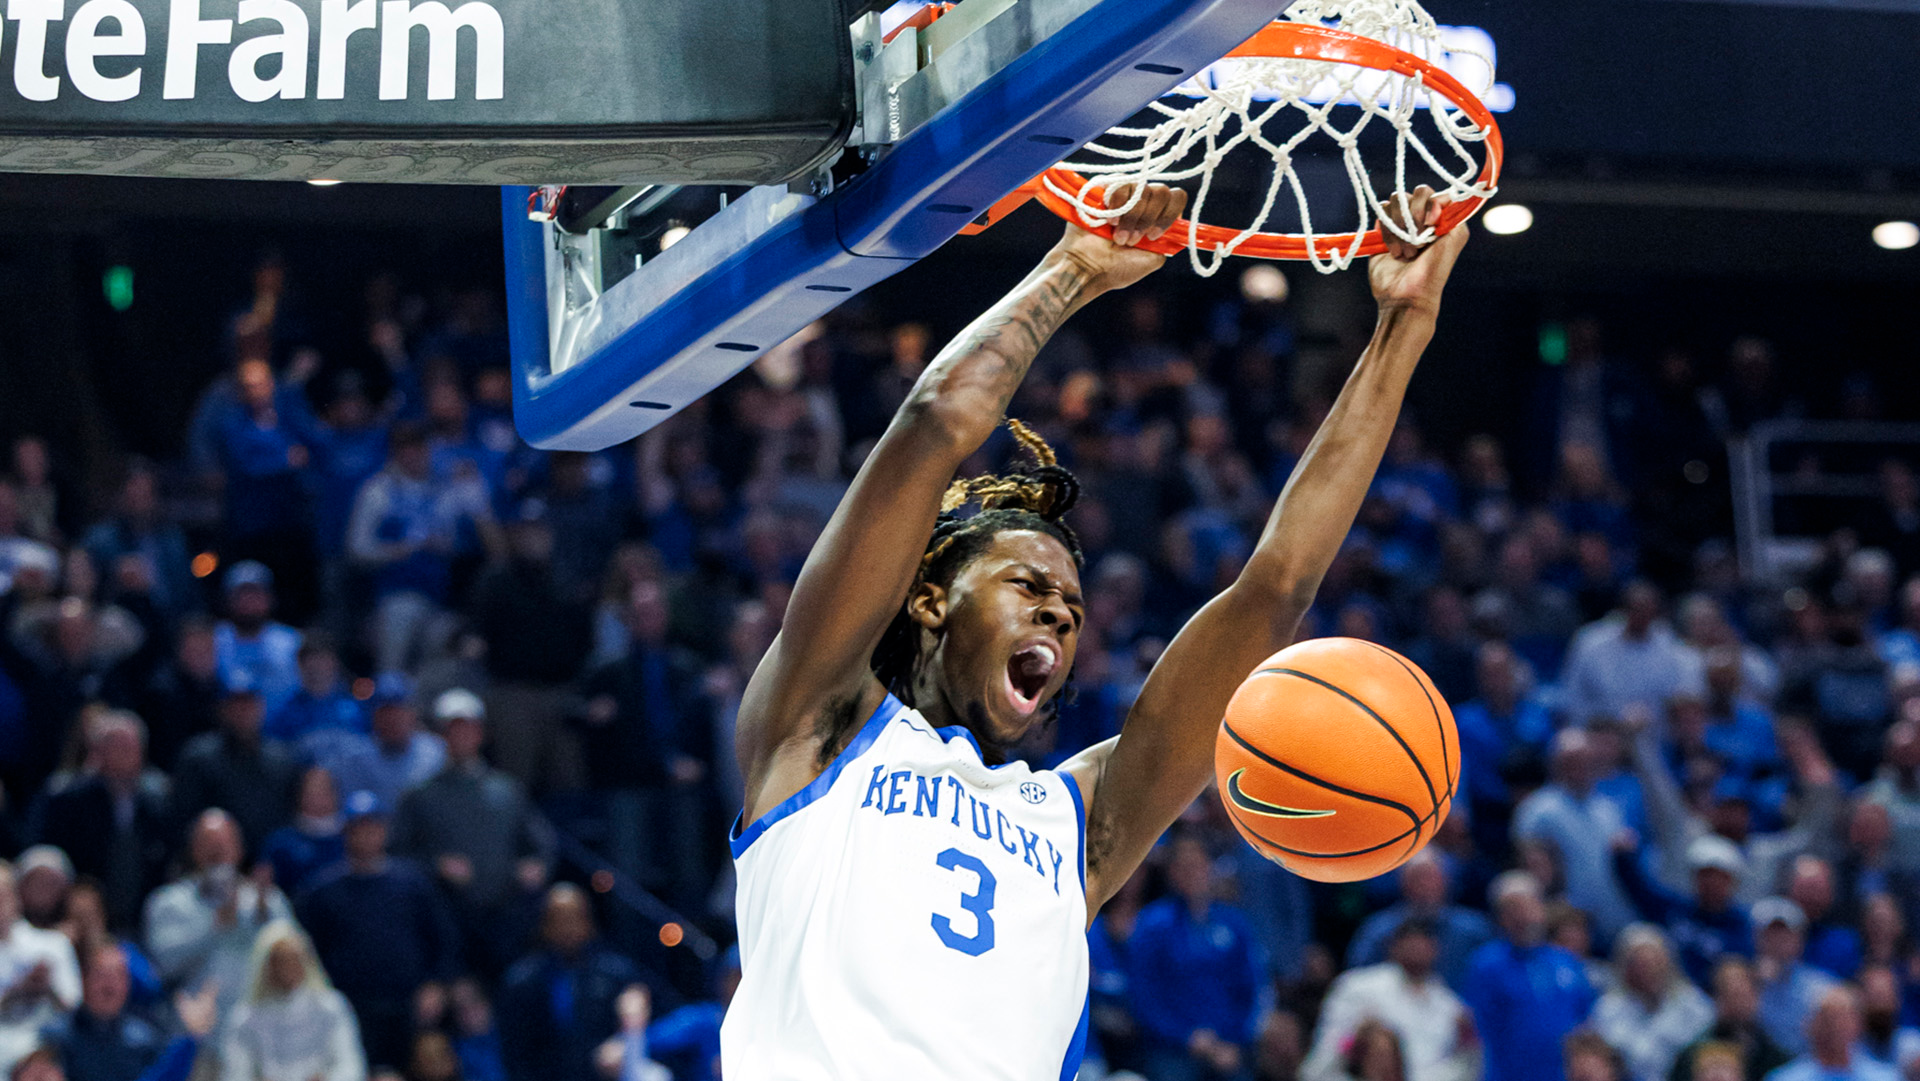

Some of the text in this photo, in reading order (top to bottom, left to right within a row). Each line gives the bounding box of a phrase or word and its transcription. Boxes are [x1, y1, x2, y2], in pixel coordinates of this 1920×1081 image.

[861, 765, 1062, 897] KENTUCKY
[1020, 782, 1046, 804] SEC
[931, 847, 997, 957] 3
